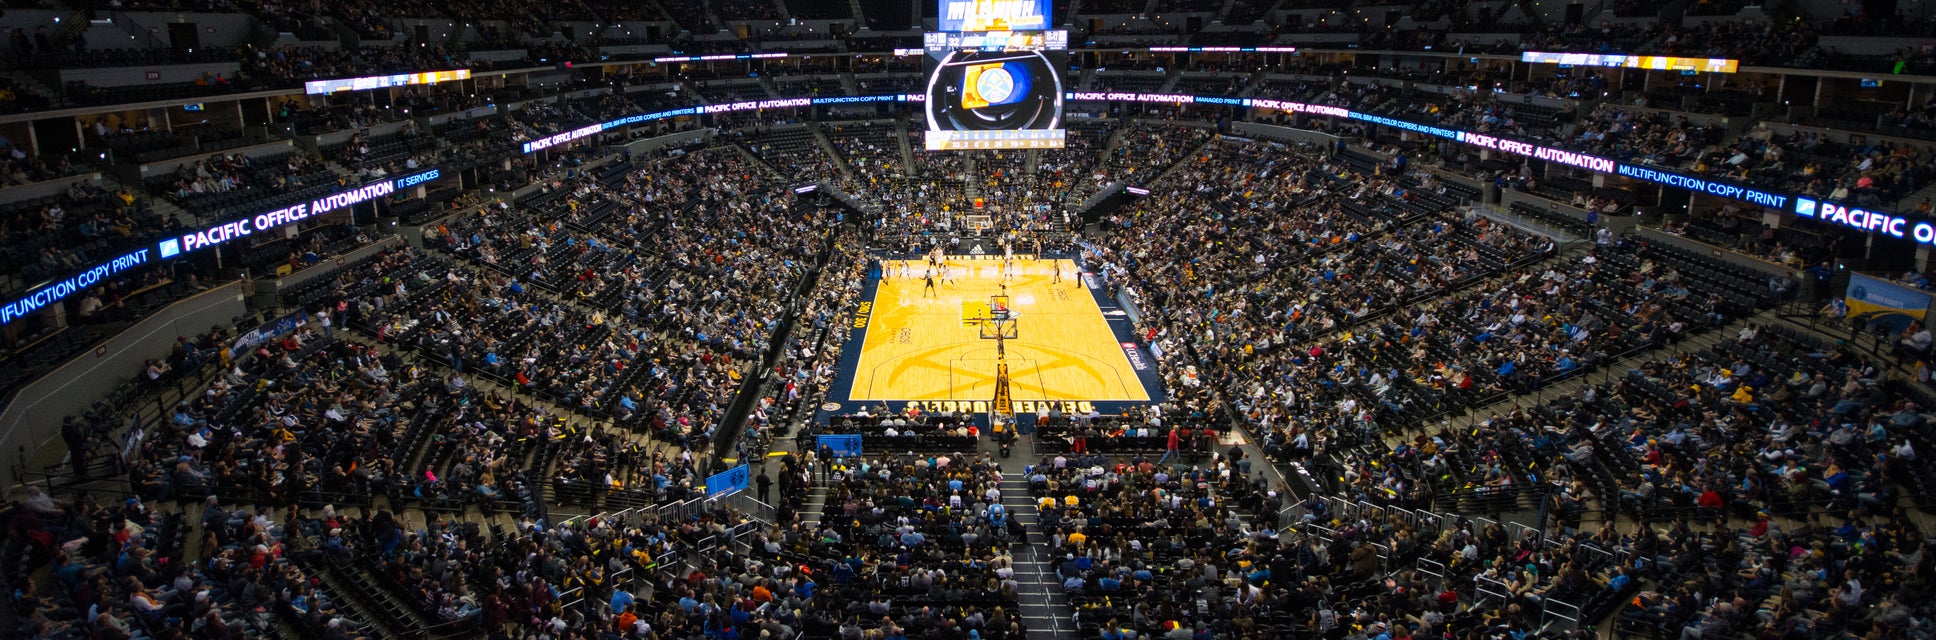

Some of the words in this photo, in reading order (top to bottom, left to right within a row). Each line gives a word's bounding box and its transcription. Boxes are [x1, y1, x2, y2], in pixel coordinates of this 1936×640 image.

[948, 37, 960, 47] 32
[1031, 36, 1042, 46] 35
[1589, 55, 1599, 65] 32
[705, 104, 731, 113] PACIFIC
[731, 101, 757, 111] OFFICE
[758, 98, 810, 109] AUTOMATION
[813, 96, 859, 104] MULTIFUNCTION
[1075, 92, 1105, 100] PACIFIC
[1107, 93, 1135, 101] OFFICE
[1137, 93, 1193, 103] AUTOMATION
[1252, 99, 1280, 109] PACIFIC
[1281, 101, 1304, 112] OFFICE
[1306, 104, 1348, 118] AUTOMATION
[1382, 117, 1397, 126] COLOR
[1397, 120, 1417, 130] COPIERS
[1418, 124, 1429, 133] AND
[1429, 126, 1455, 139] PRINTERS
[531, 138, 552, 151] PACIFIC
[553, 131, 571, 144] OFFICE
[571, 123, 602, 139] AUTOMATION
[627, 115, 643, 123] COLOR
[1466, 132, 1497, 149] PACIFIC
[1499, 139, 1532, 156] OFFICE
[1534, 147, 1614, 173] AUTOMATION
[1619, 164, 1705, 191] MULTIFUNCTION
[1707, 183, 1743, 199] COPY
[1746, 190, 1787, 208] PRINT
[1821, 203, 1906, 237] PACIFIC
[1914, 223, 1936, 246] O
[0, 277, 76, 324] IFUNCTION
[78, 262, 110, 288] COPY
[113, 249, 148, 273] PRINT
[183, 219, 251, 251] PACIFIC
[254, 204, 307, 230] OFFICE
[311, 180, 394, 215] AUTOMATION
[397, 179, 405, 189] IT
[405, 170, 439, 187] SERVICES
[906, 401, 992, 413] UGGES
